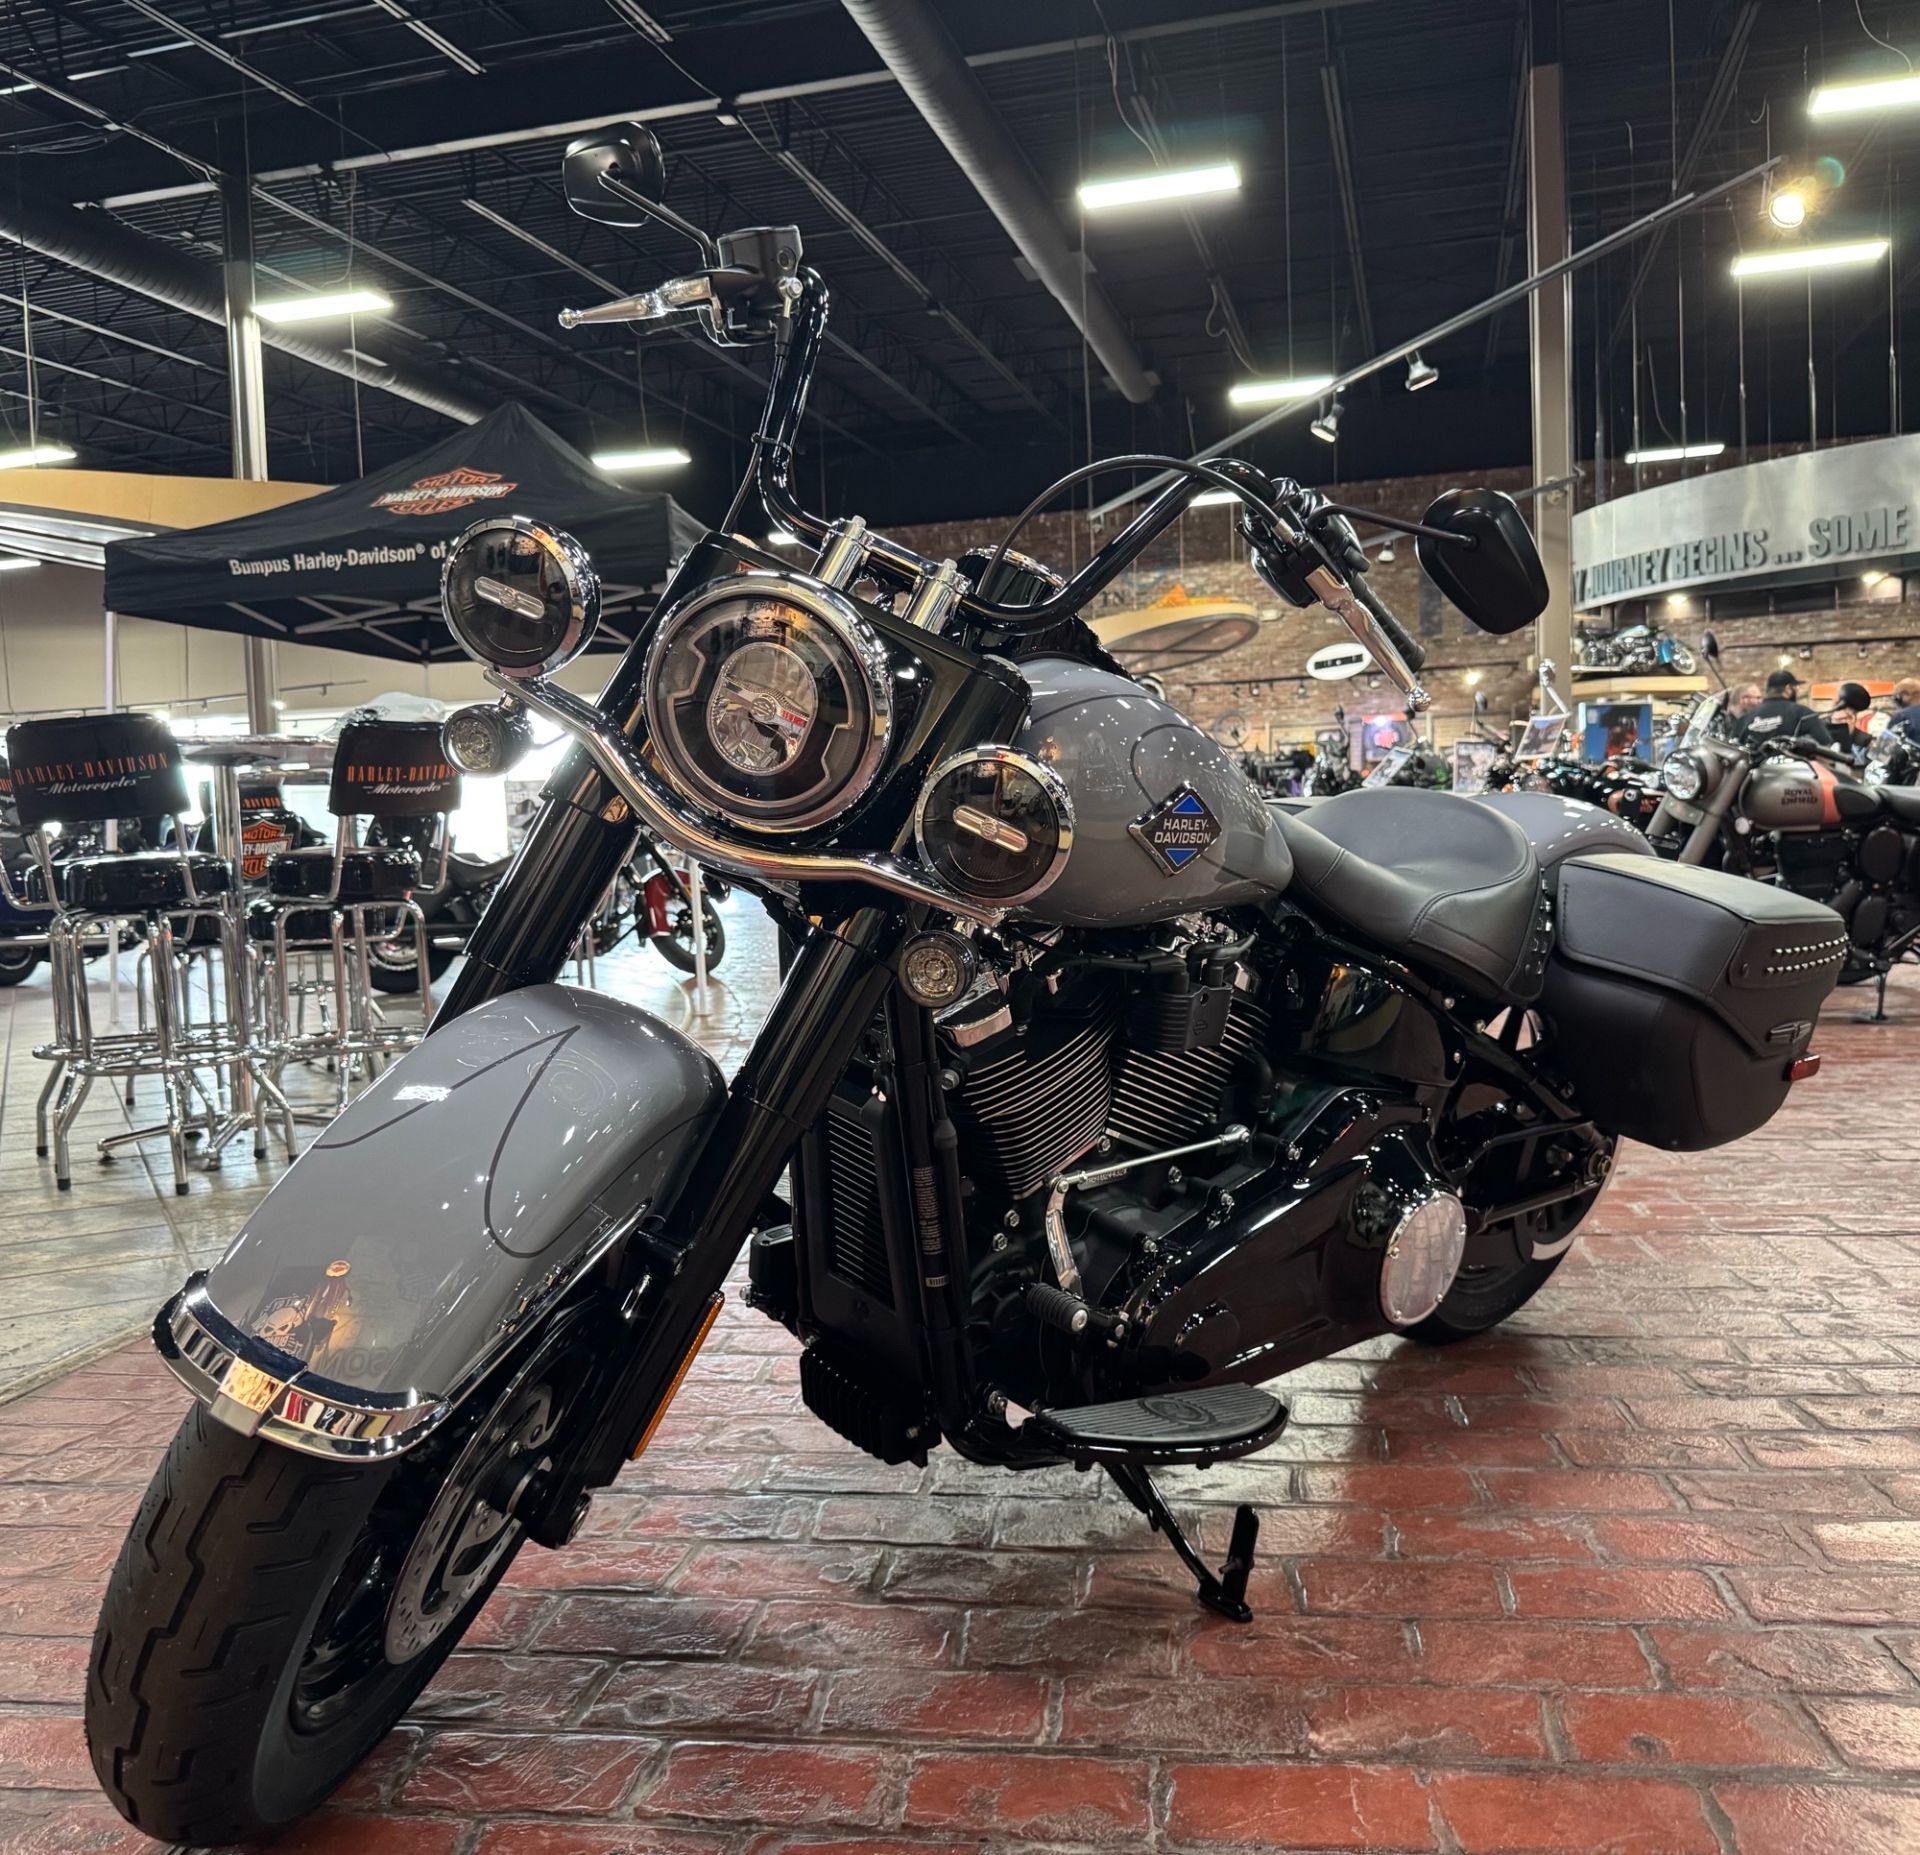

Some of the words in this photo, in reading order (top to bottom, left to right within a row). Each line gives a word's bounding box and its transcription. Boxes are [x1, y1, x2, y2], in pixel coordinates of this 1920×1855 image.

[423, 472, 486, 488] MOTOR
[381, 485, 508, 504] HARLEY-DAVIDSON
[229, 559, 291, 577] Bumpus
[430, 541, 447, 559] of
[1587, 548, 1671, 598] JOURNEY
[1808, 505, 1910, 559] SOME
[14, 752, 168, 785] HARLEY-DAVIDSON
[43, 776, 137, 796] Motorcycles
[367, 782, 442, 796] Motorcycles
[1784, 788, 1813, 797] ROYAL
[1163, 818, 1209, 831] HARLEY-
[243, 827, 278, 839] MOTOR
[1154, 832, 1211, 844] DAVIDSON
